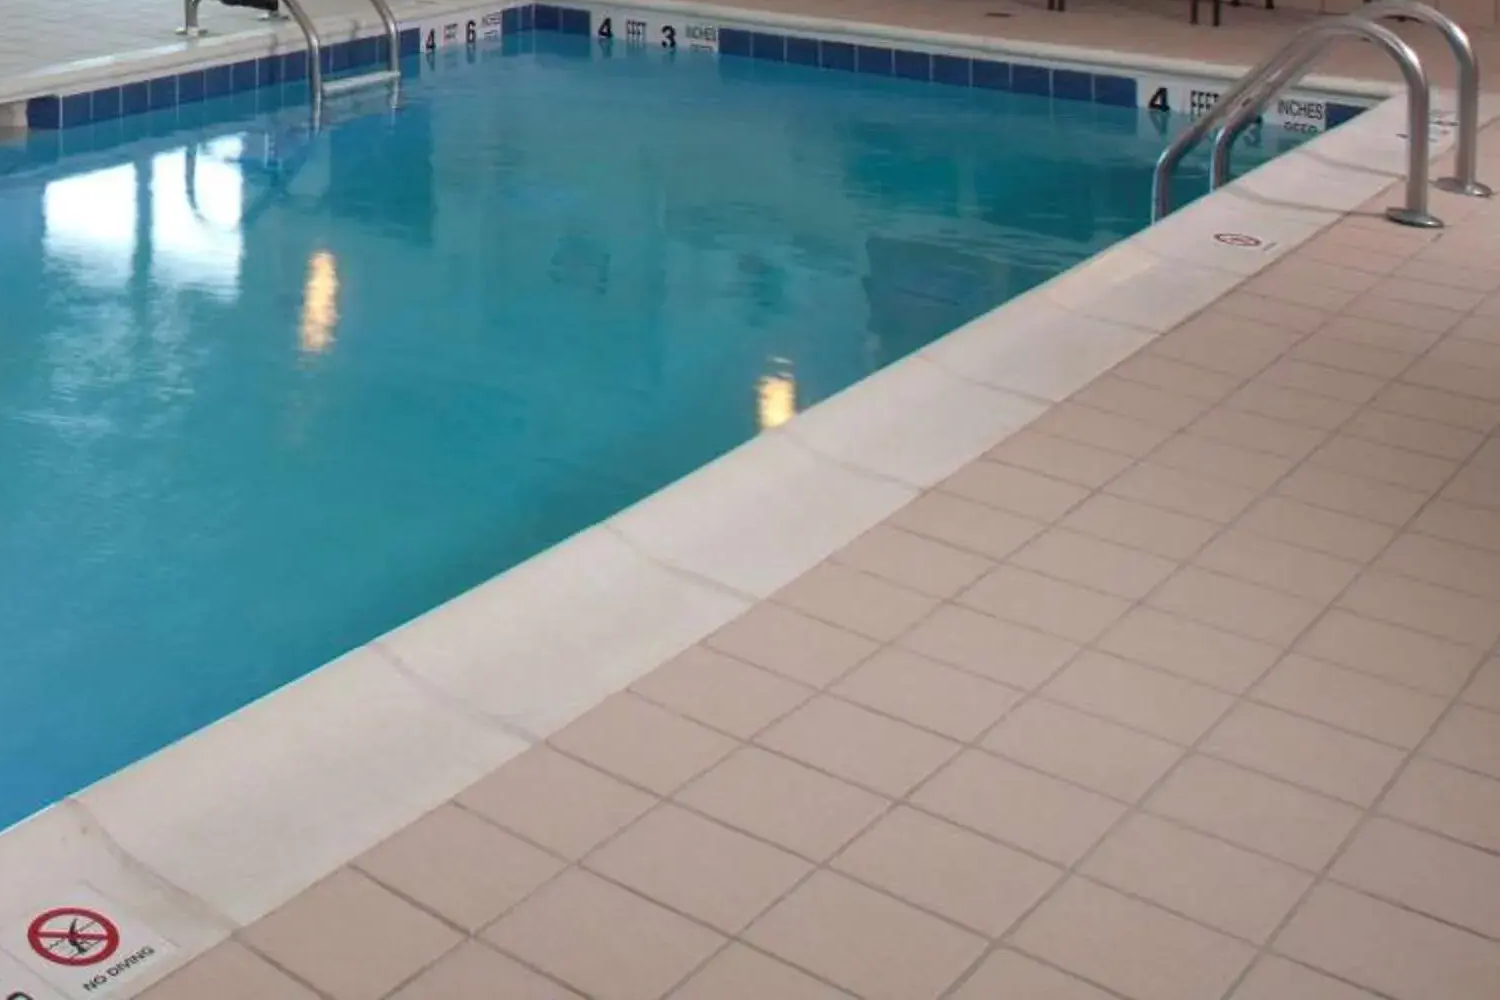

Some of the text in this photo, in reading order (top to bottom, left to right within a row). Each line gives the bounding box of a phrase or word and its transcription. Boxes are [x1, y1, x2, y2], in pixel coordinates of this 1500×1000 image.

[425, 27, 436, 49] 4
[466, 19, 477, 43] 6
[598, 17, 613, 38] 4
[661, 24, 677, 49] 3
[1148, 87, 1170, 112] 4
[1277, 99, 1324, 120] INCHES
[83, 945, 156, 991] NO DIVING
